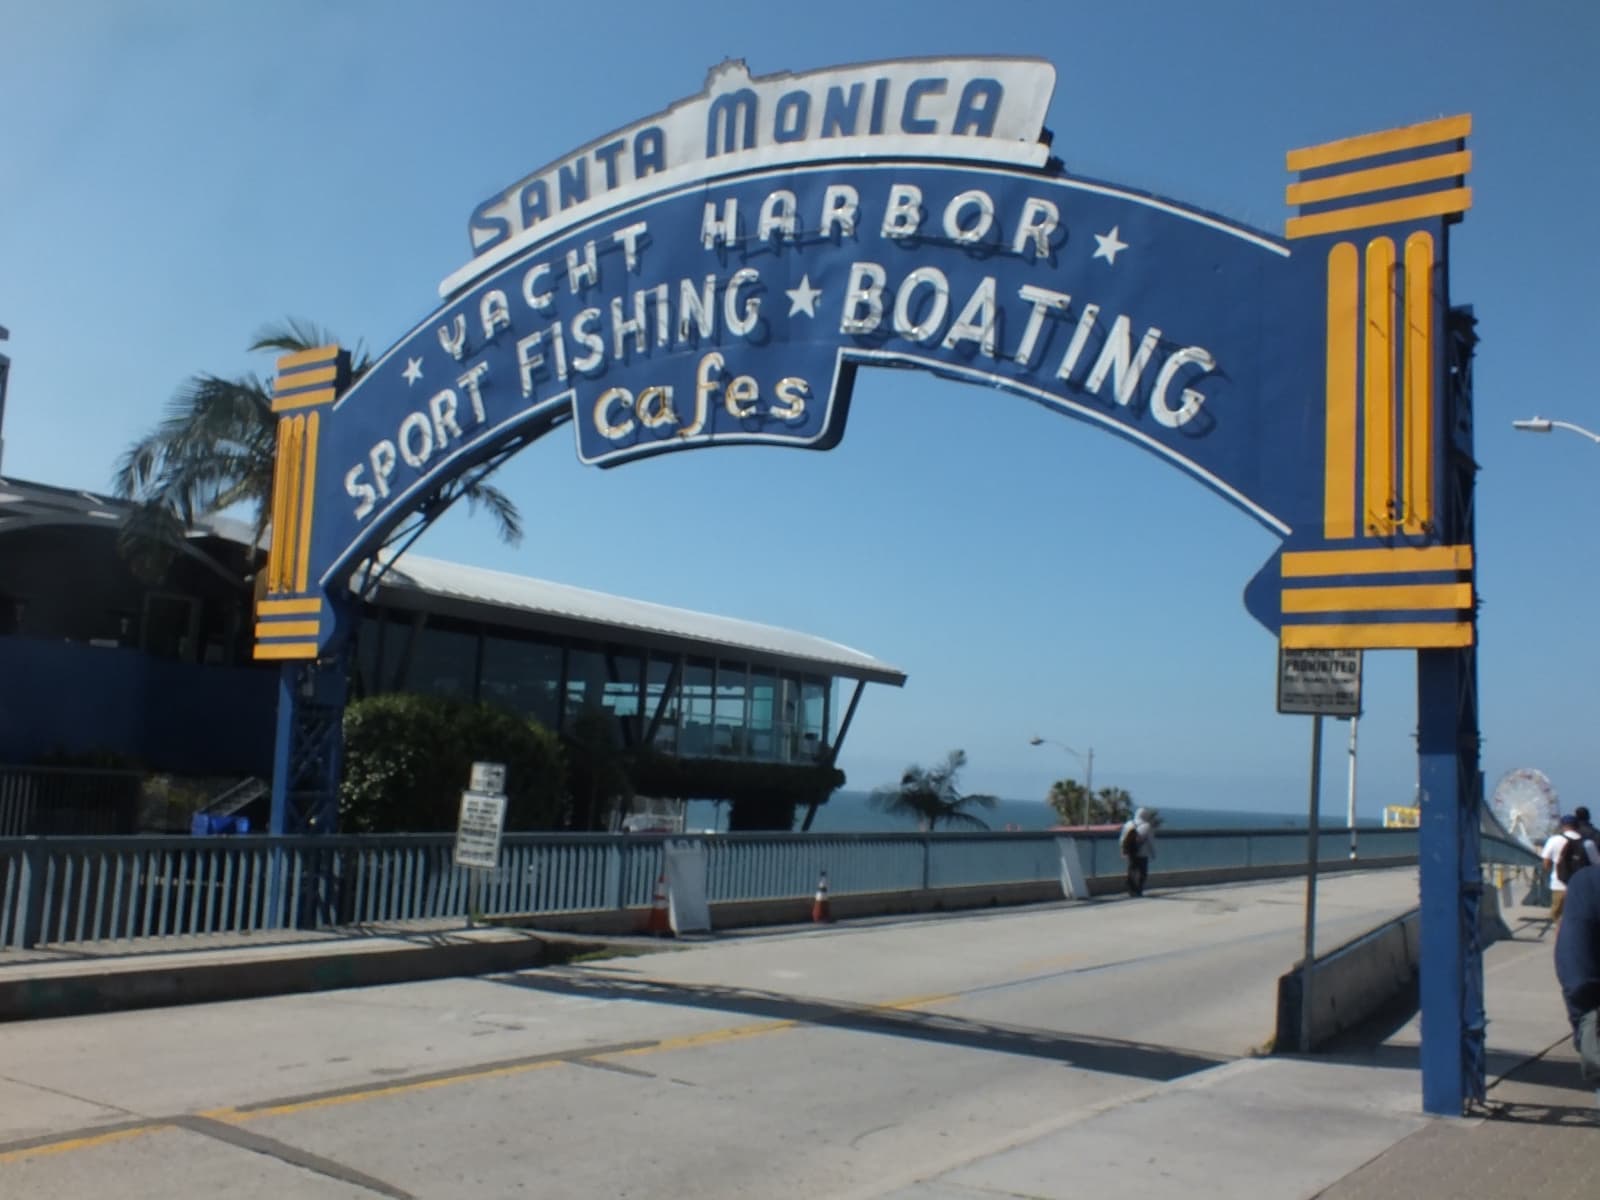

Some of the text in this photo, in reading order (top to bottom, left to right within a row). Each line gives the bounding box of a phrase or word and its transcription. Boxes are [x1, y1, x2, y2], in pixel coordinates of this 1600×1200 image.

[470, 77, 1004, 252] SANTA MONICA
[438, 184, 1060, 360] YACHT HARBOR
[345, 262, 1216, 521] SPORT FISHING BOATING
[594, 352, 809, 440] cafes
